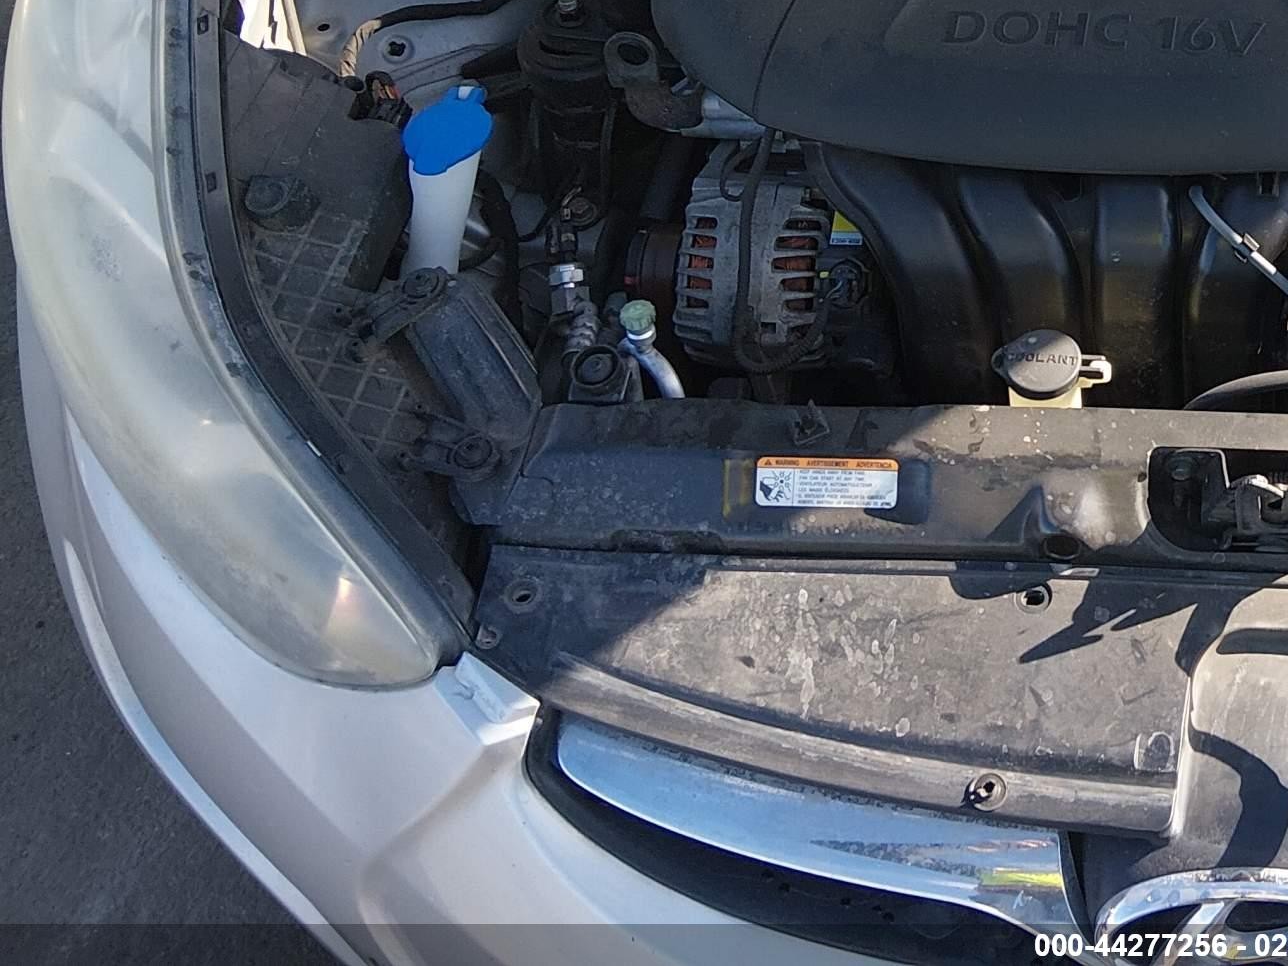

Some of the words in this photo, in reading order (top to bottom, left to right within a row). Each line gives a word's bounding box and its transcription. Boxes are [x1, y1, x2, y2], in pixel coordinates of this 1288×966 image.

[942, 10, 1132, 52] DOHC
[1157, 14, 1270, 57] 16V
[775, 459, 800, 467] WARNING
